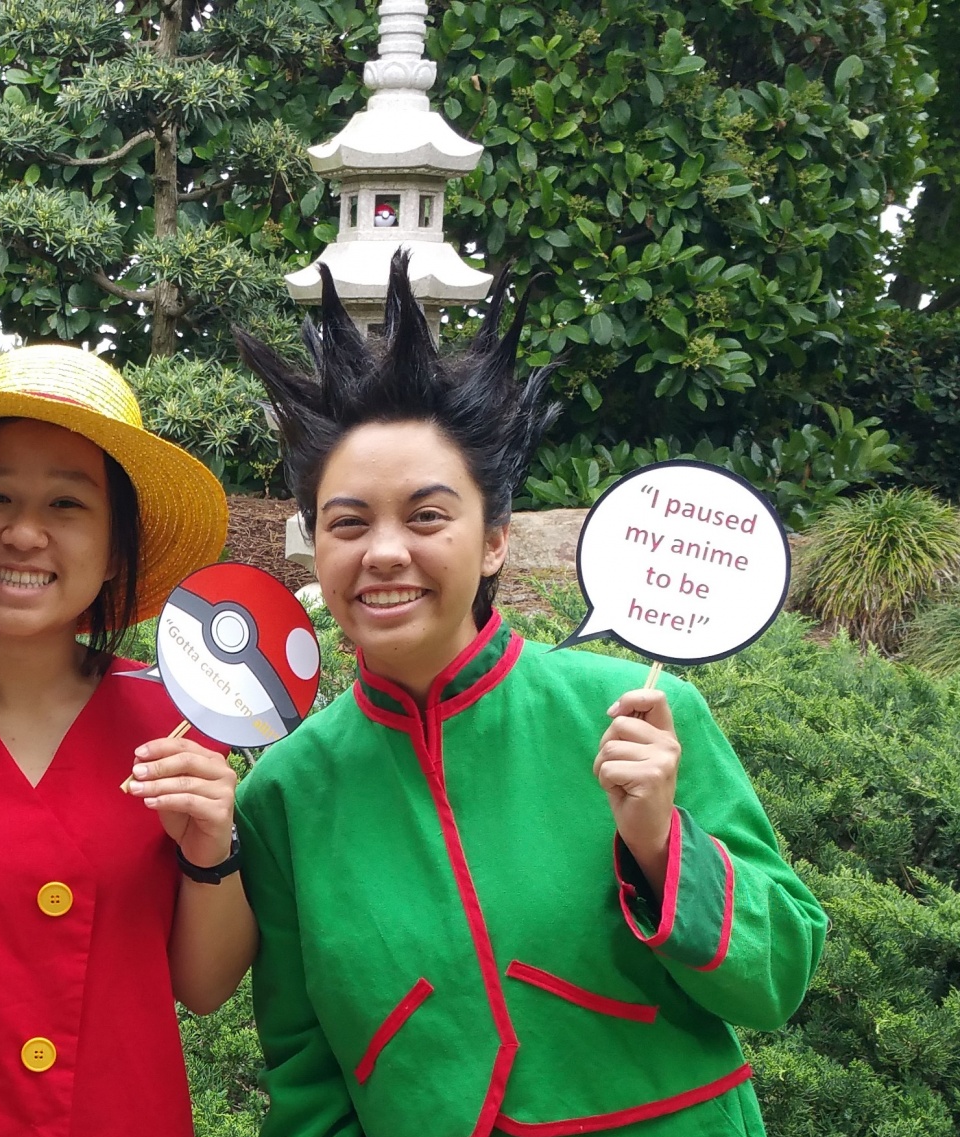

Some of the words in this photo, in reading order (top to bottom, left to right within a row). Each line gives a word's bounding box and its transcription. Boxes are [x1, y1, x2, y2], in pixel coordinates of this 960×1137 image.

[640, 484, 660, 509] “I
[664, 497, 758, 535] paused
[624, 525, 665, 553] my
[670, 538, 749, 571] anime
[645, 566, 671, 589] to
[679, 573, 710, 599] be
[627, 598, 710, 634] here!”
[166, 618, 200, 662] “Gotta
[200, 661, 231, 695] catch
